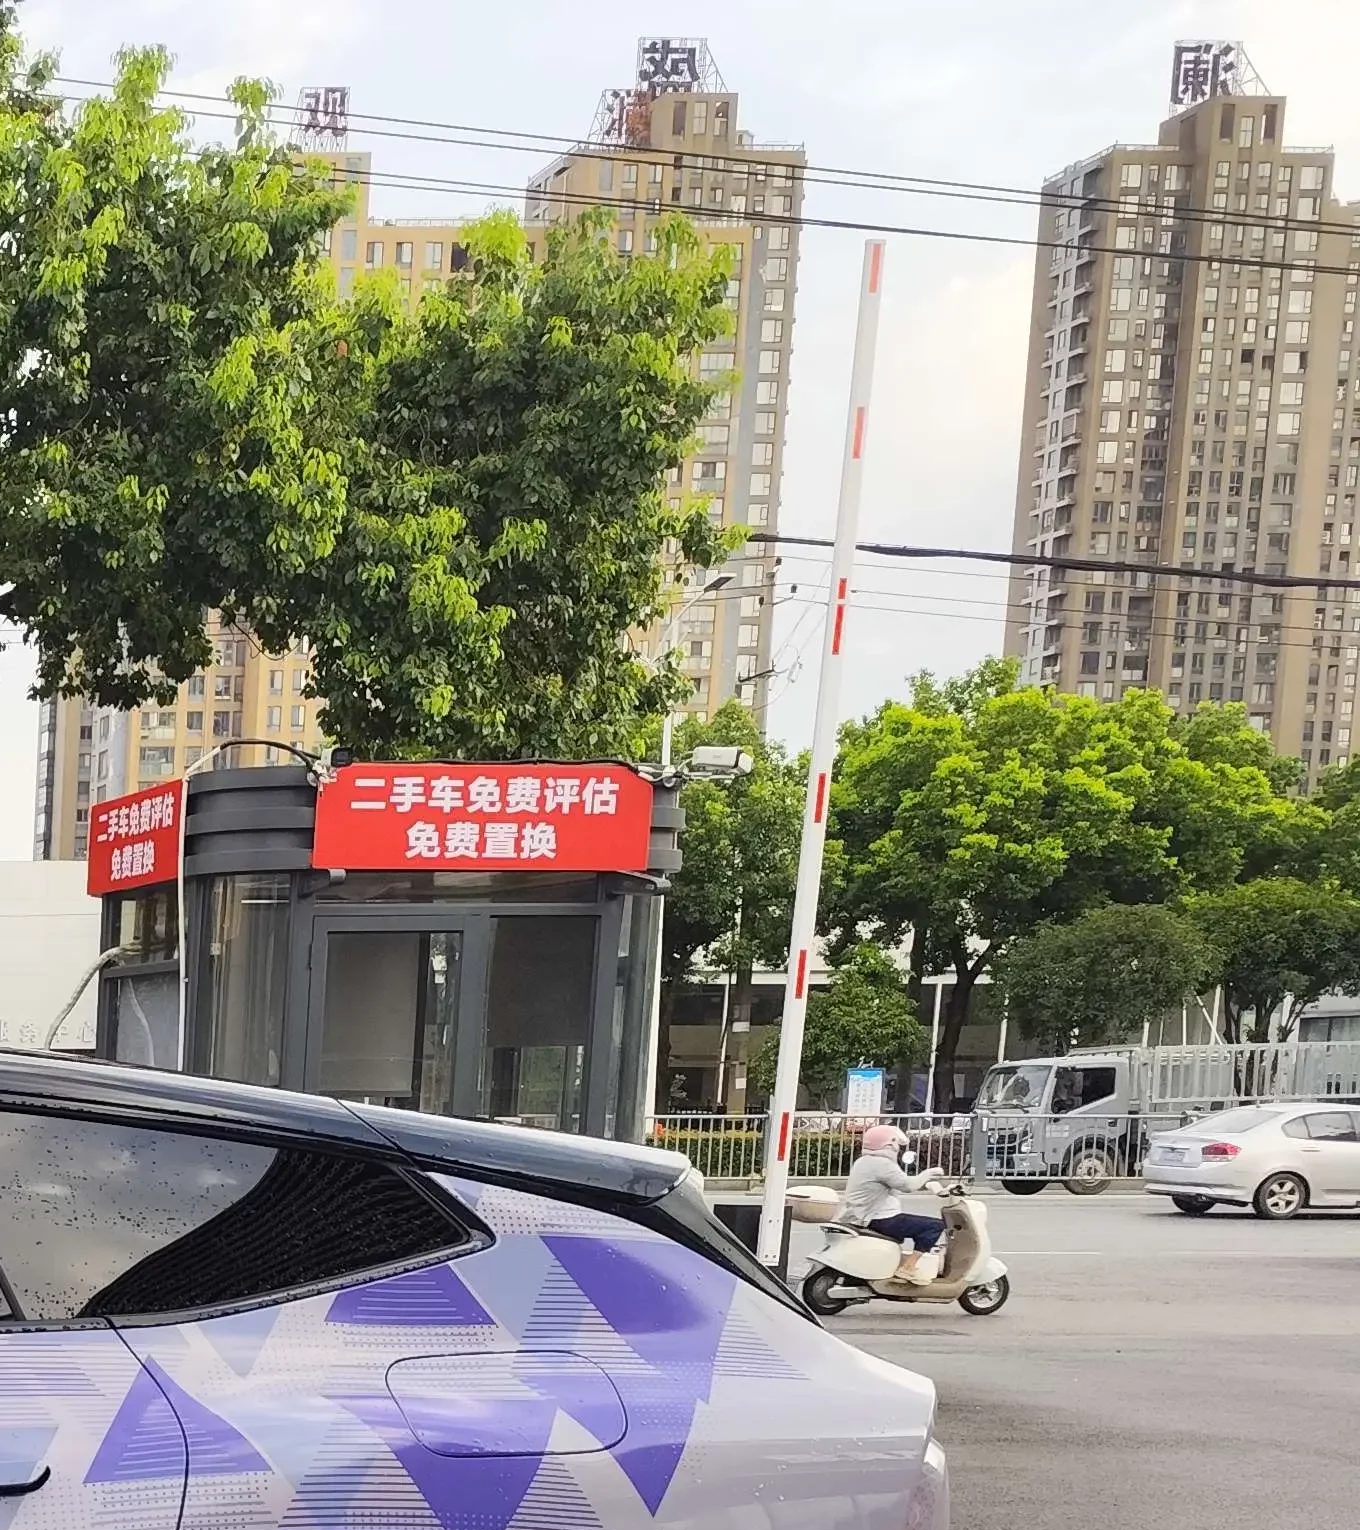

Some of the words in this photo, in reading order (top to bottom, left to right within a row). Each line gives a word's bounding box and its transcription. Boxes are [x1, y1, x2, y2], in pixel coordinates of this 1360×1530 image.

[350, 776, 620, 815] 二手车免费评估
[96, 791, 175, 843] 二手车免费评估
[110, 839, 156, 882] 免费置换
[404, 820, 558, 860] 免费置换
